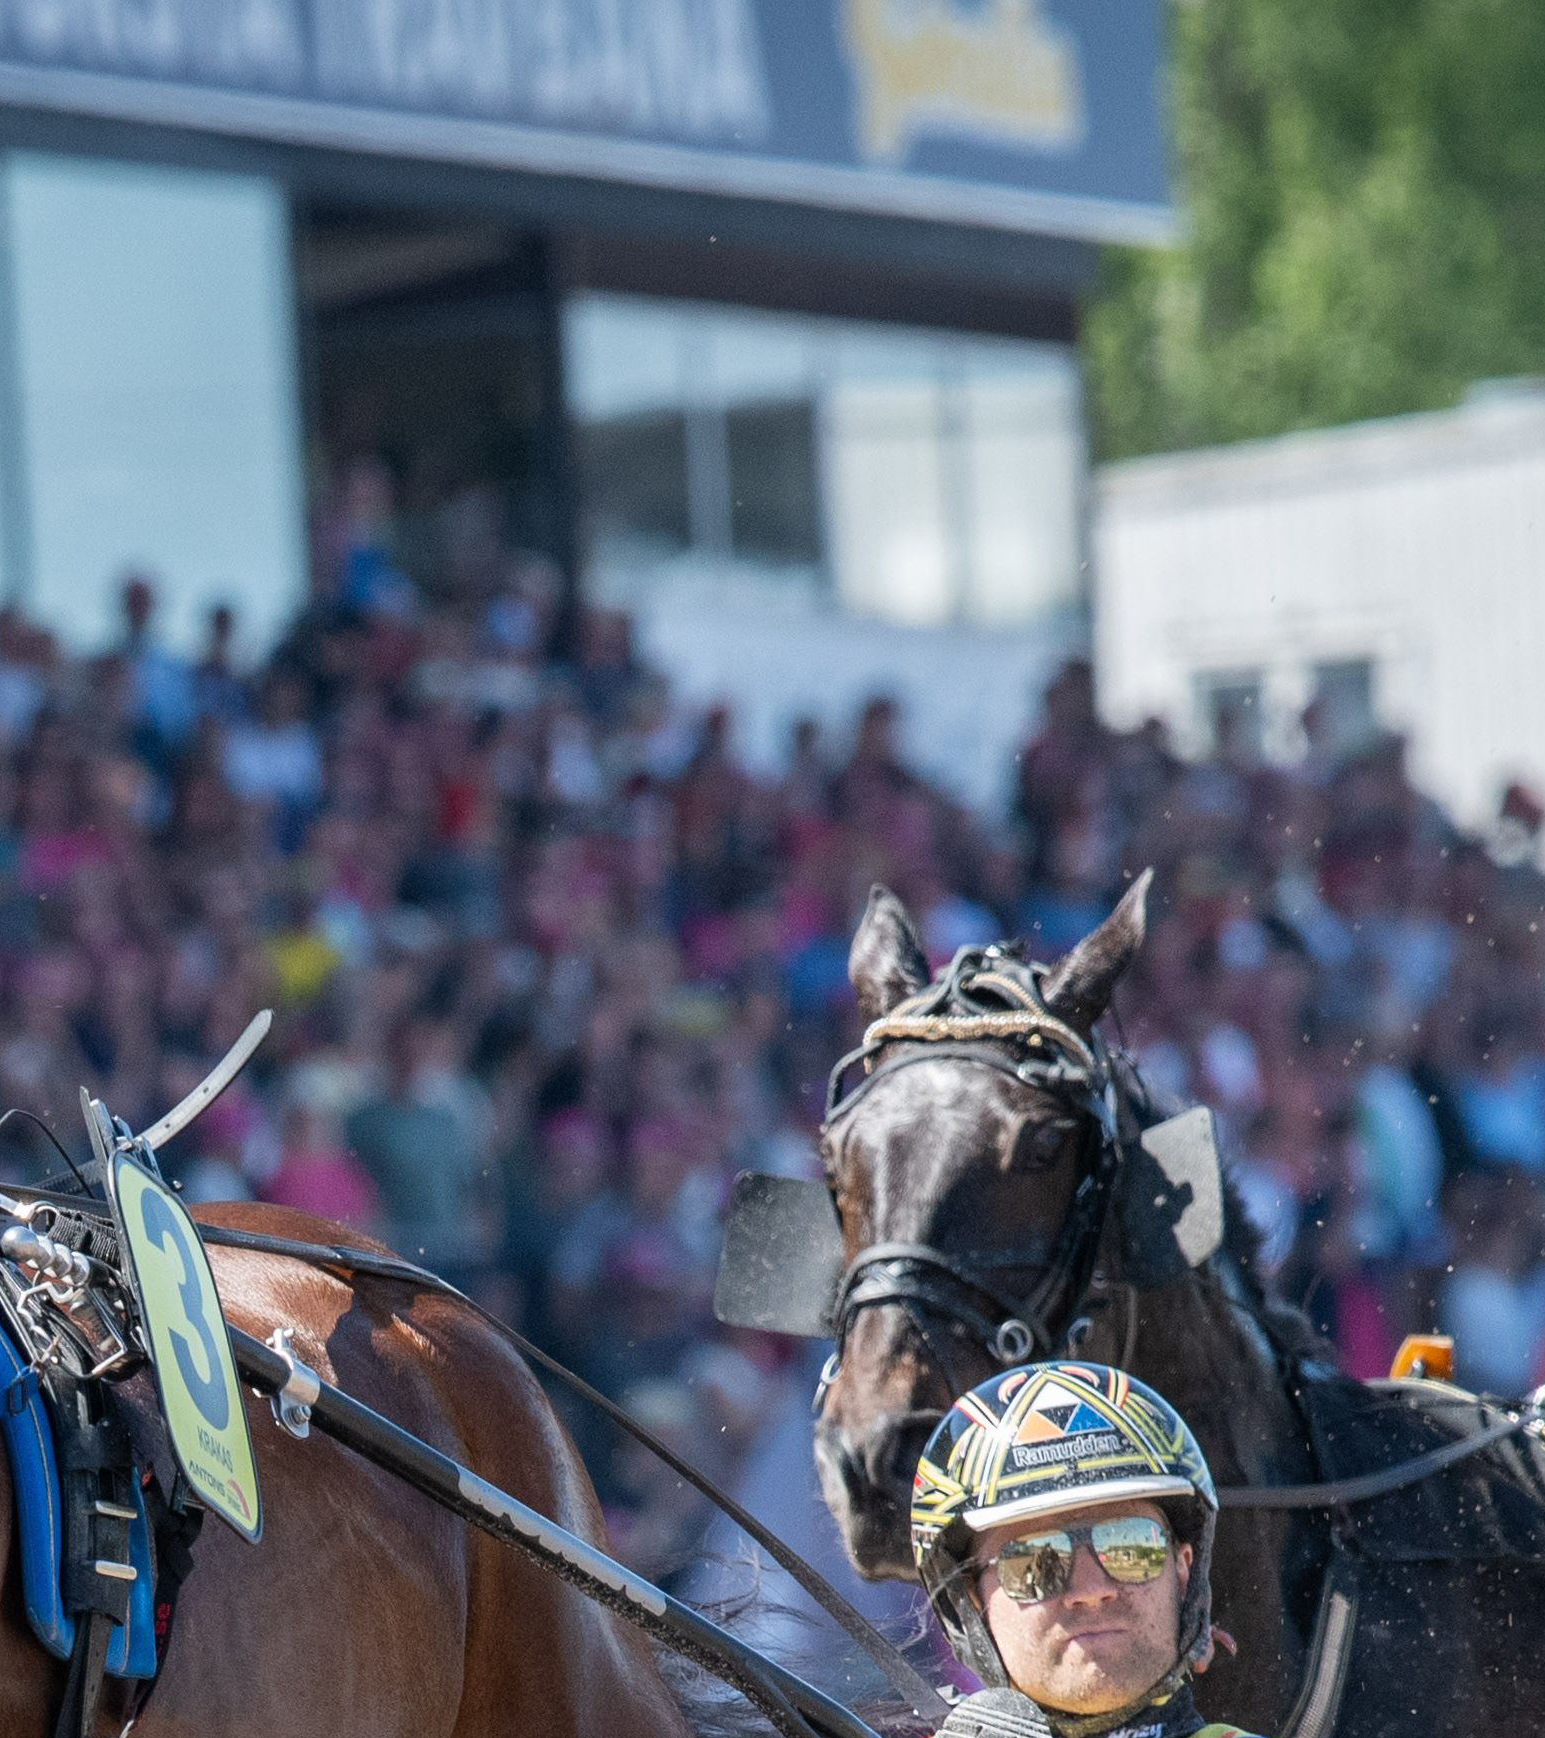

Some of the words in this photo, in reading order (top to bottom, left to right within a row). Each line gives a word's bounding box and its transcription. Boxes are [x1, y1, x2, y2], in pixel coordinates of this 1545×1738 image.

[140, 1188, 230, 1431] 3
[197, 1424, 233, 1473] KRAKAS
[1013, 1434, 1121, 1467] Ramudden
